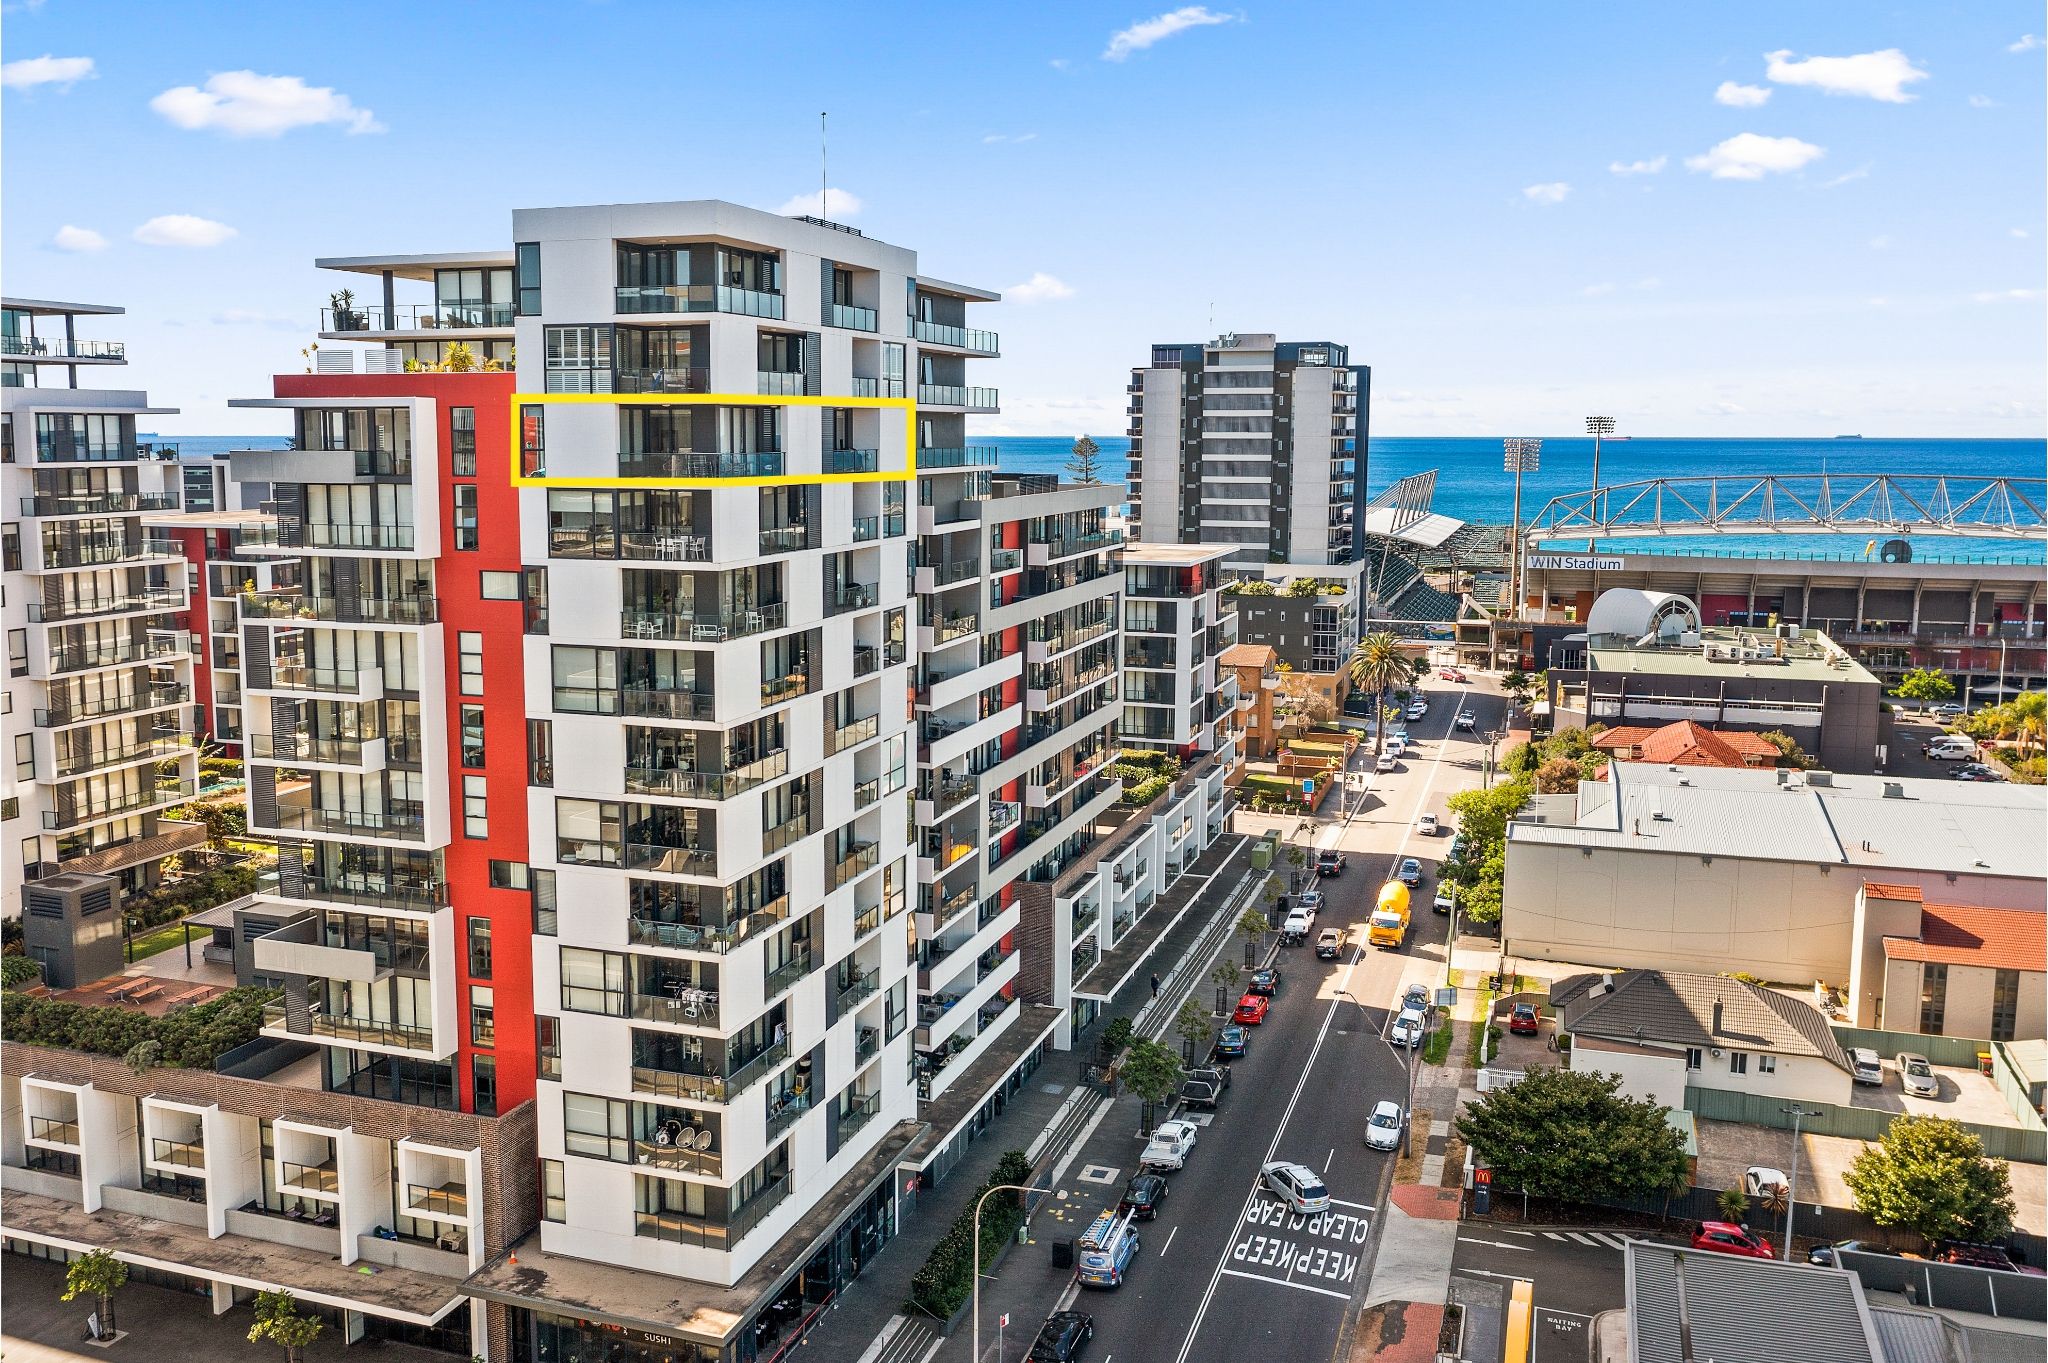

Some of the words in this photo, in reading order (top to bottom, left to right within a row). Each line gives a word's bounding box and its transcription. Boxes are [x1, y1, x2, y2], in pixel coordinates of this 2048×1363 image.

[1531, 556, 1562, 568] WIN
[1565, 557, 1621, 570] Stadium
[1309, 1211, 1369, 1244] CLEAR
[1233, 1234, 1296, 1269] KEEP
[1296, 1246, 1358, 1283] KEEP
[1547, 1317, 1582, 1328] WAITING
[1555, 1324, 1572, 1332] BAY
[644, 1332, 672, 1345] SUSHI
